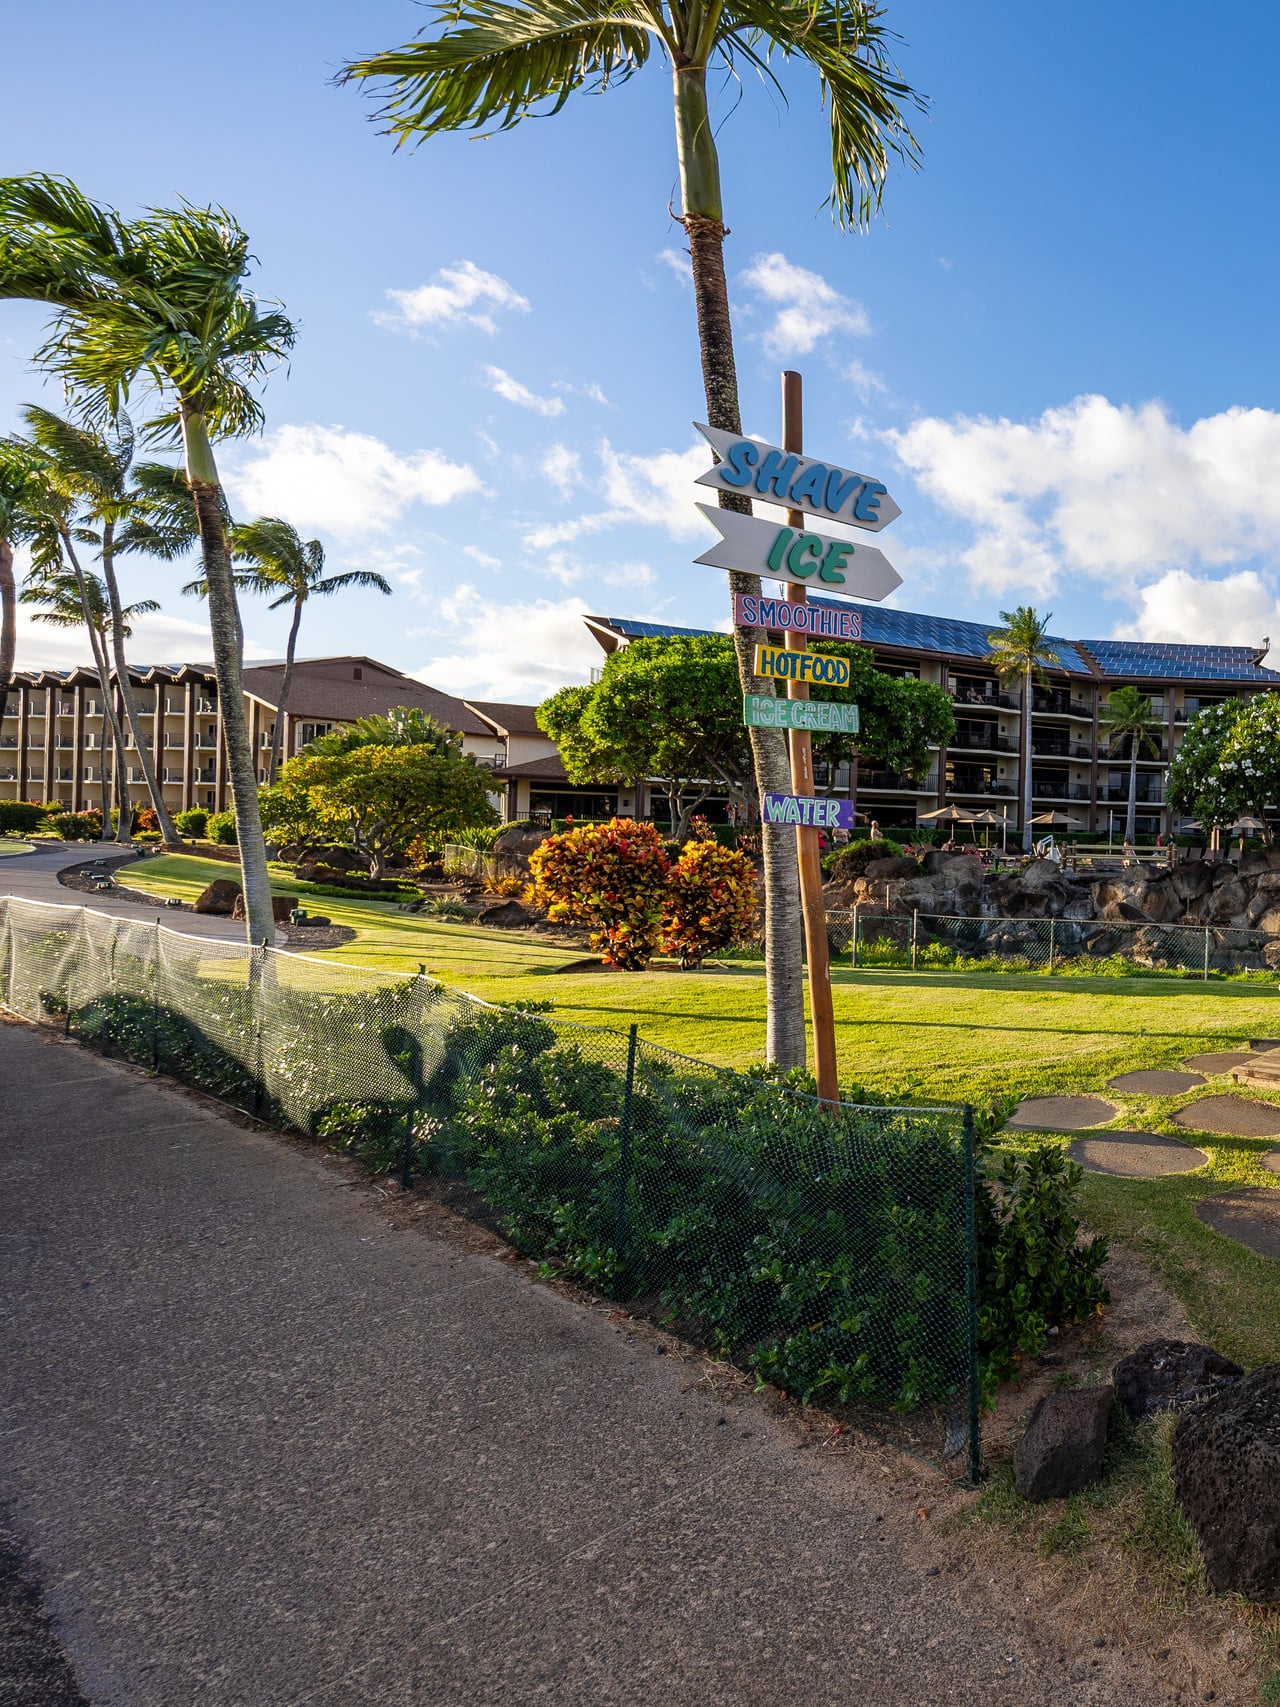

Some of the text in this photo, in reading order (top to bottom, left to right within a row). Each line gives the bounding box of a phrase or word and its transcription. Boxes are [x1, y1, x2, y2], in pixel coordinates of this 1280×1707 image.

[720, 441, 888, 522] SHAVE
[768, 527, 855, 583] ICE
[743, 597, 860, 638] SMOOTHIES
[761, 649, 849, 684] HOTFOOD
[751, 697, 859, 731] ICE CREAM
[765, 796, 840, 827] WATER
